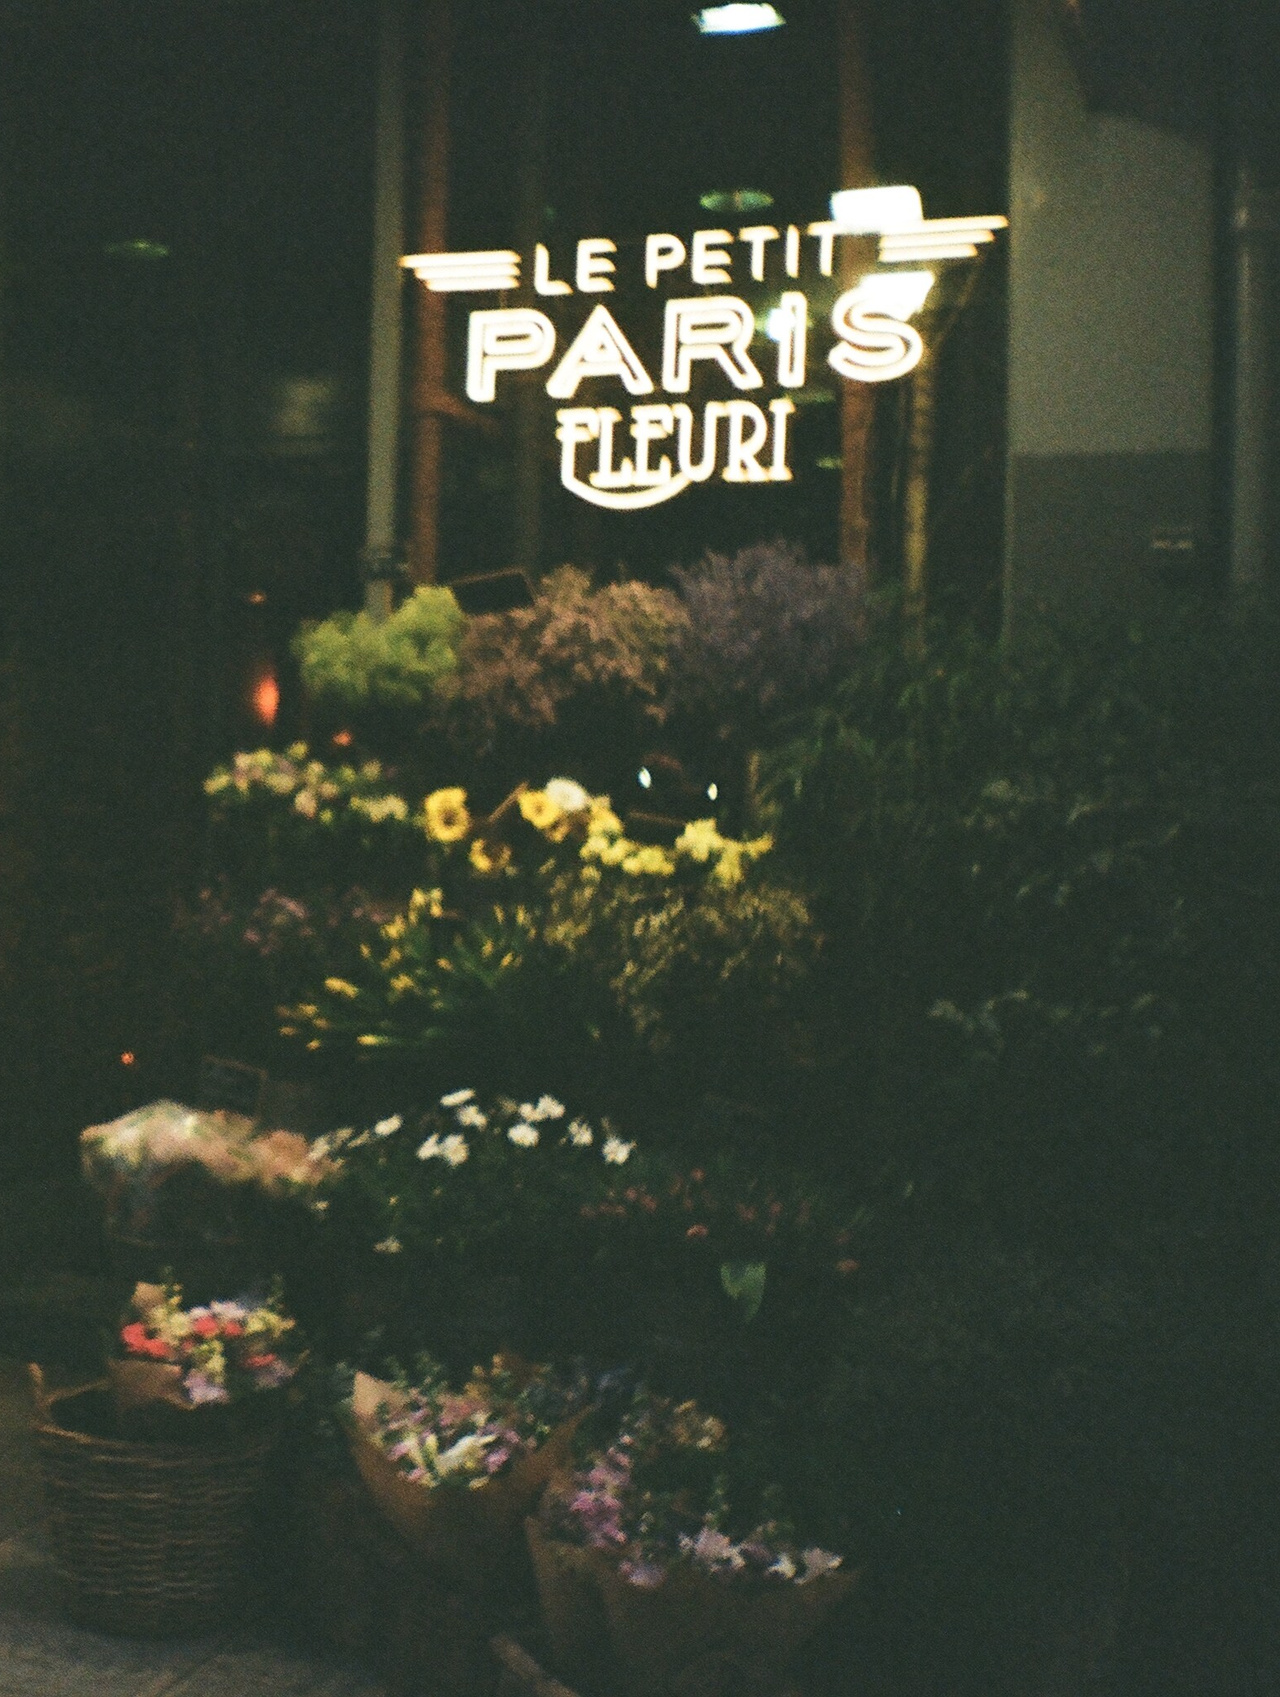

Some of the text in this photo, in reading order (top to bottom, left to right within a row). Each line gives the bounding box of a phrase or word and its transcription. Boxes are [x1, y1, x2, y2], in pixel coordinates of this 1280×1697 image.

[533, 222, 842, 296] LE PETIT
[465, 290, 926, 402] PARIS
[556, 399, 797, 510] FLEURI
